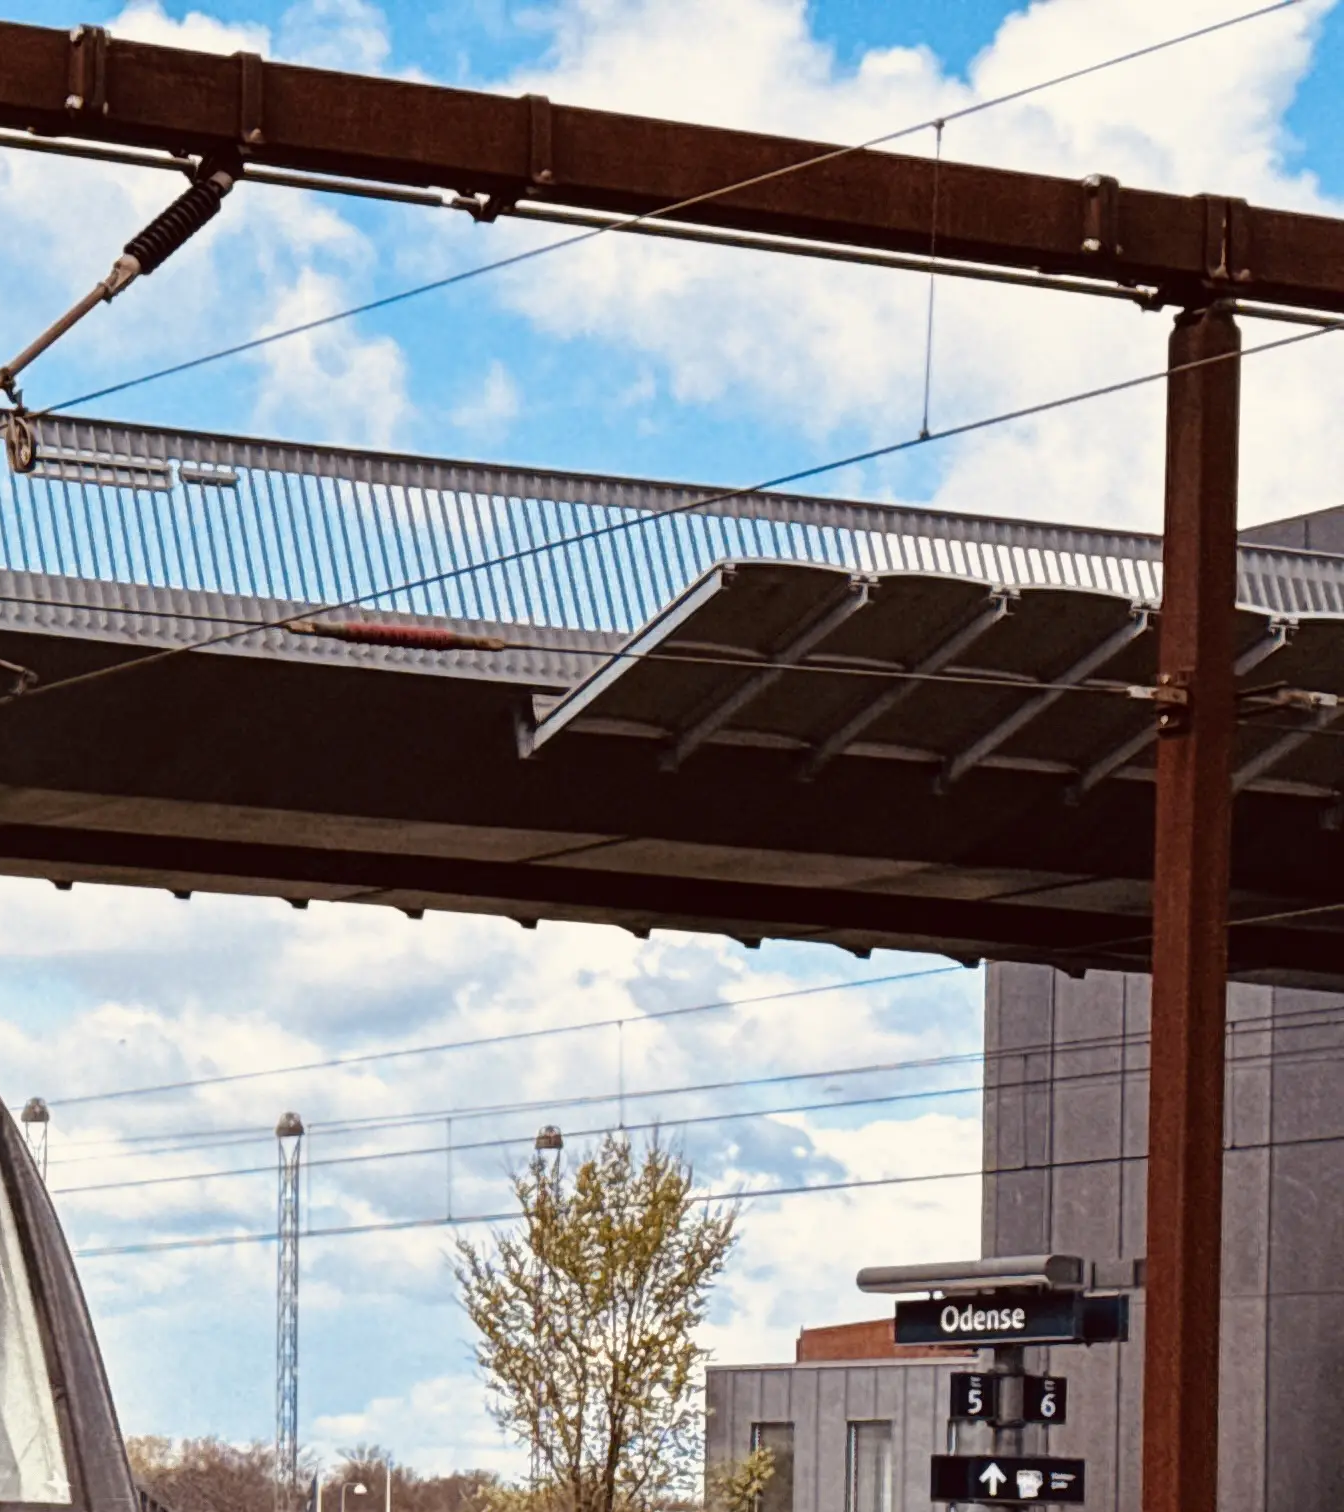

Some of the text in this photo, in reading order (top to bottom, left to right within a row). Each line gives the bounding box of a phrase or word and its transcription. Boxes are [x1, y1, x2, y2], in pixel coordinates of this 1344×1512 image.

[941, 1304, 1025, 1333] Odense
[968, 1390, 983, 1414] 5
[1040, 1393, 1056, 1417] 6
